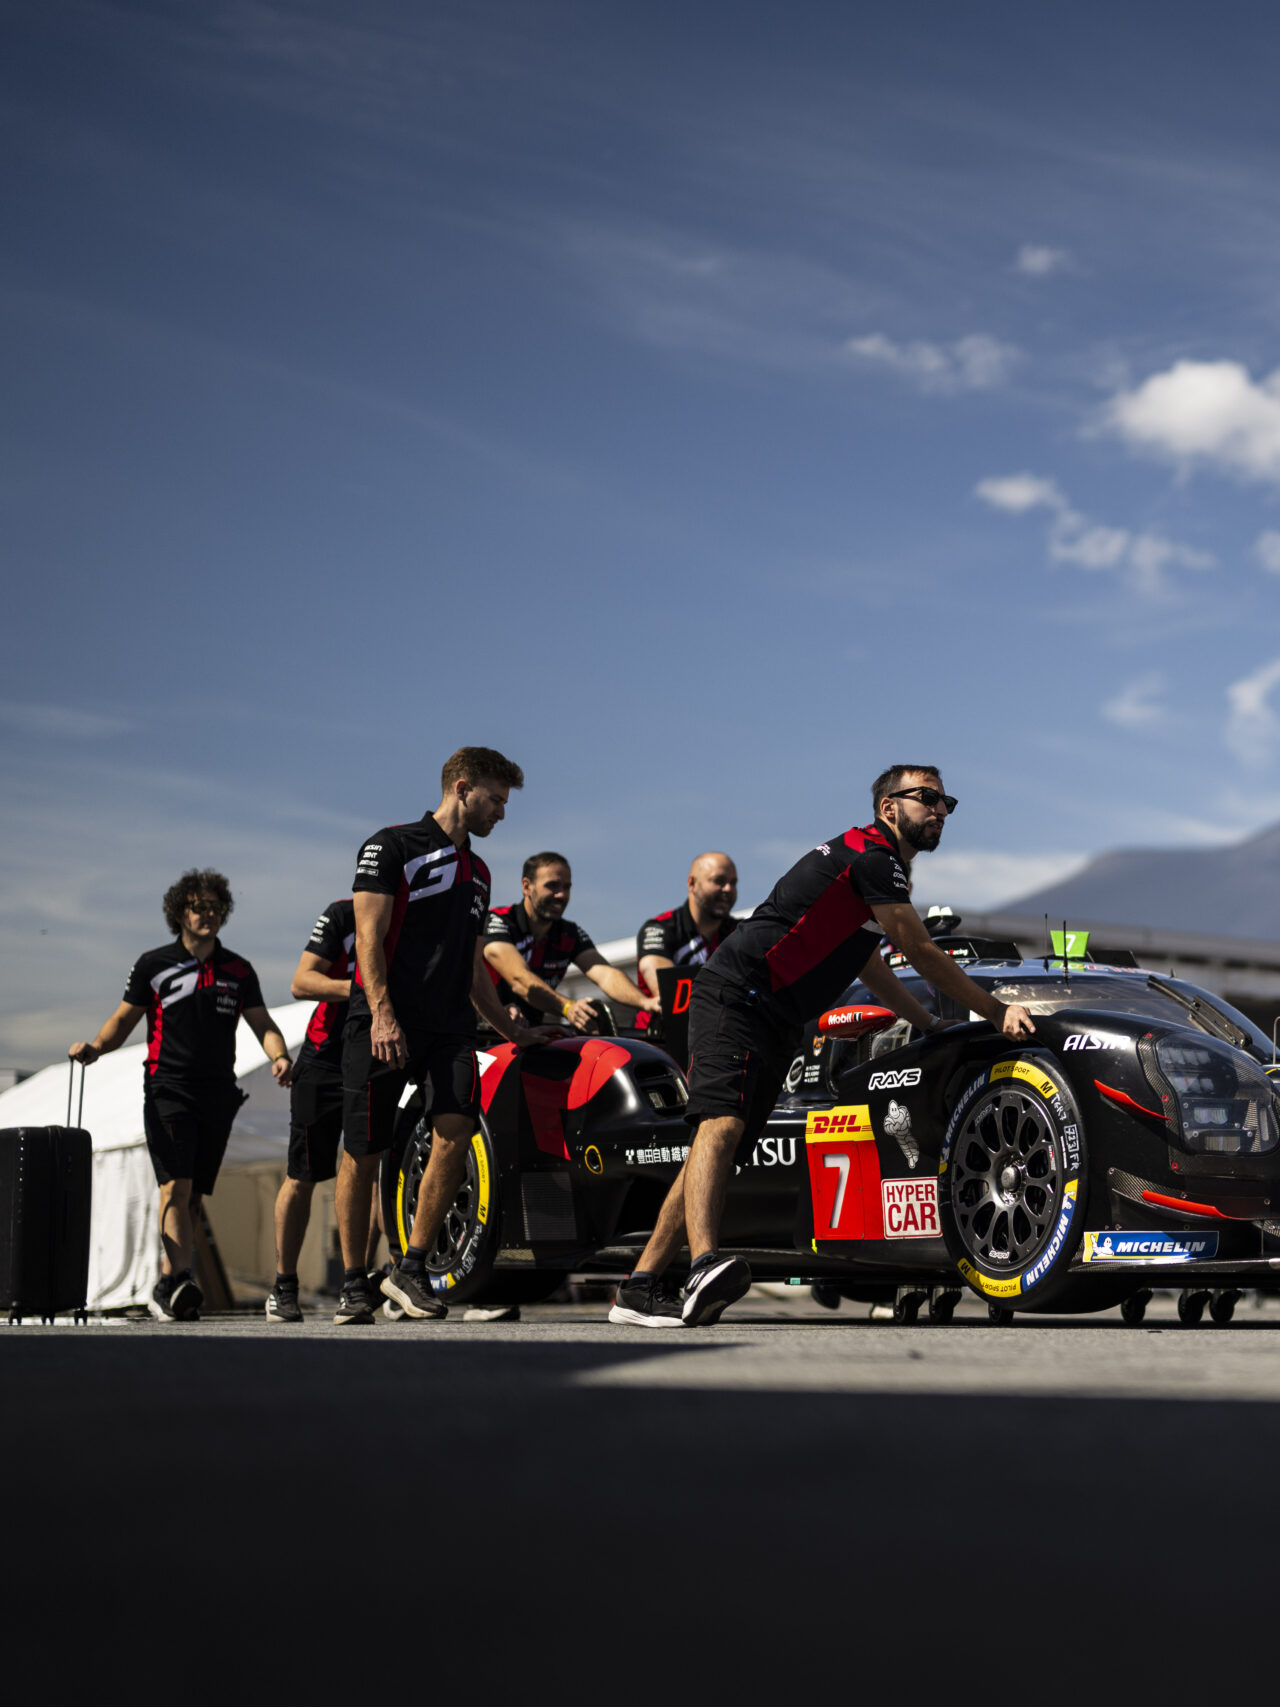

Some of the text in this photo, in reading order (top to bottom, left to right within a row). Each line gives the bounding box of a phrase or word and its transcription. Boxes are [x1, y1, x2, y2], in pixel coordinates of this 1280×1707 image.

[1065, 934, 1076, 952] 7
[828, 1012, 852, 1026] Mobil
[868, 1068, 922, 1090] RAYS
[994, 1065, 1054, 1095] PILOT SPORT M
[946, 1073, 986, 1144] MICHELIN
[813, 1114, 862, 1134] DHL
[822, 1153, 850, 1229] 7
[886, 1183, 936, 1203] HYPER
[888, 1202, 938, 1233] CAR
[1026, 1213, 1069, 1286] MICHELIN
[1116, 1241, 1207, 1253] MICHELIN
